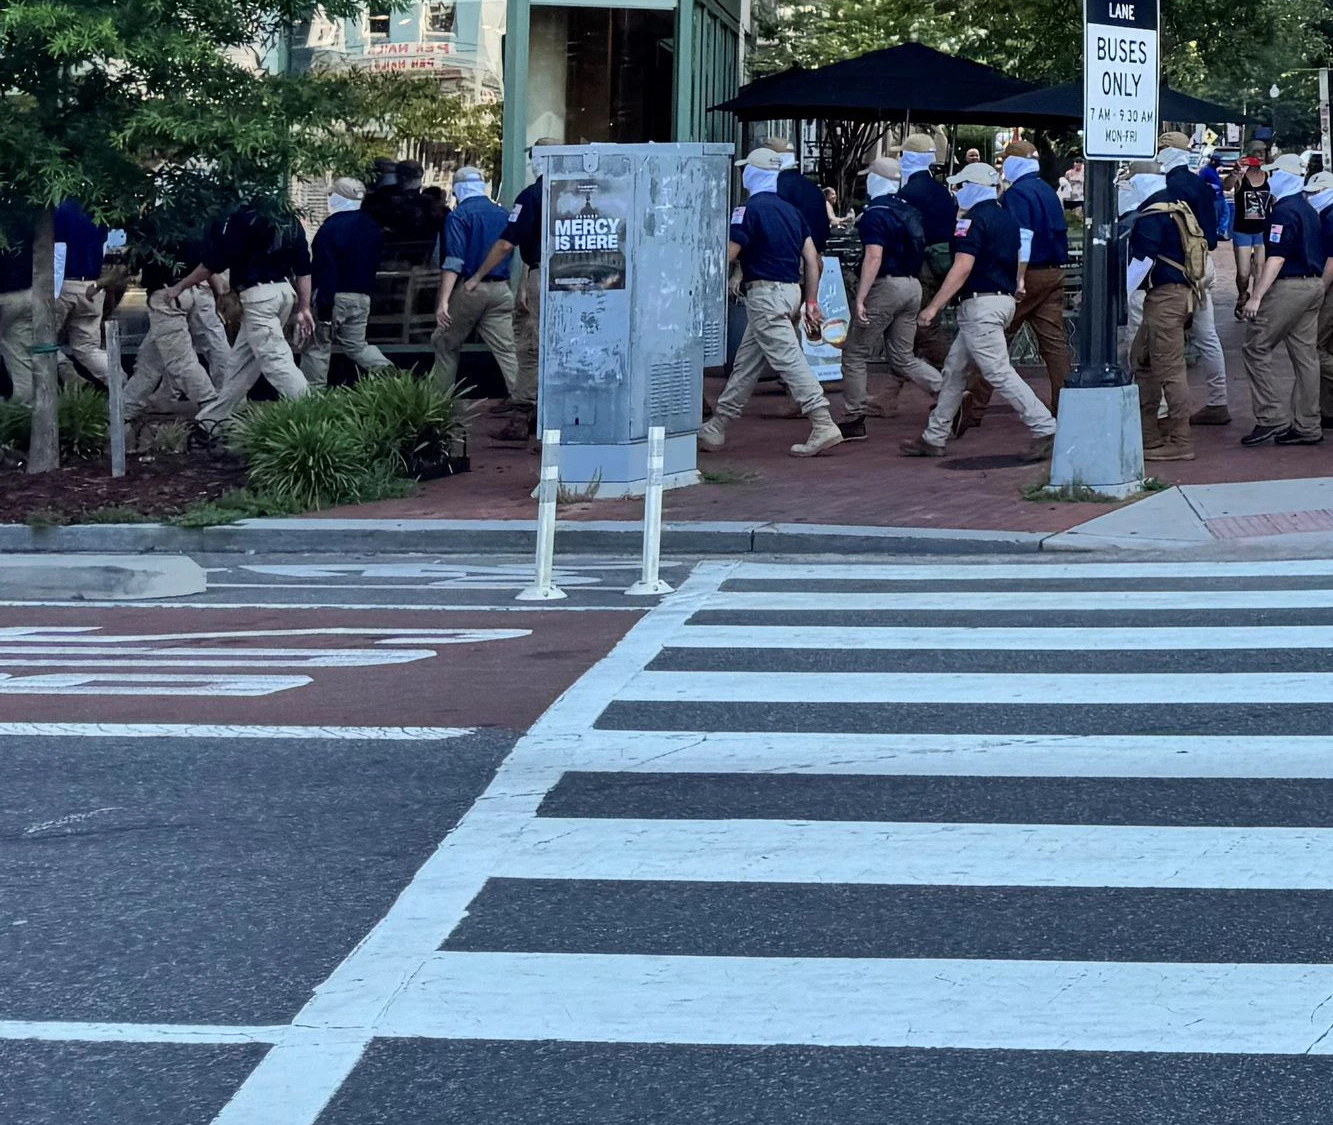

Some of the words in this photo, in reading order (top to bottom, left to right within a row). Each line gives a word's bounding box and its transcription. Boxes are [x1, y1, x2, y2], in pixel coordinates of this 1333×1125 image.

[1108, 2, 1135, 20] LANE
[1097, 36, 1147, 64] BUSES
[1102, 71, 1142, 97] ONLY
[1090, 107, 1096, 121] 7
[1098, 107, 1111, 121] AM
[1141, 111, 1154, 123] AM
[1105, 129, 1137, 143] MON-FRI
[555, 218, 620, 236] MERCY
[555, 236, 571, 250] IS
[574, 235, 618, 250] HERE
